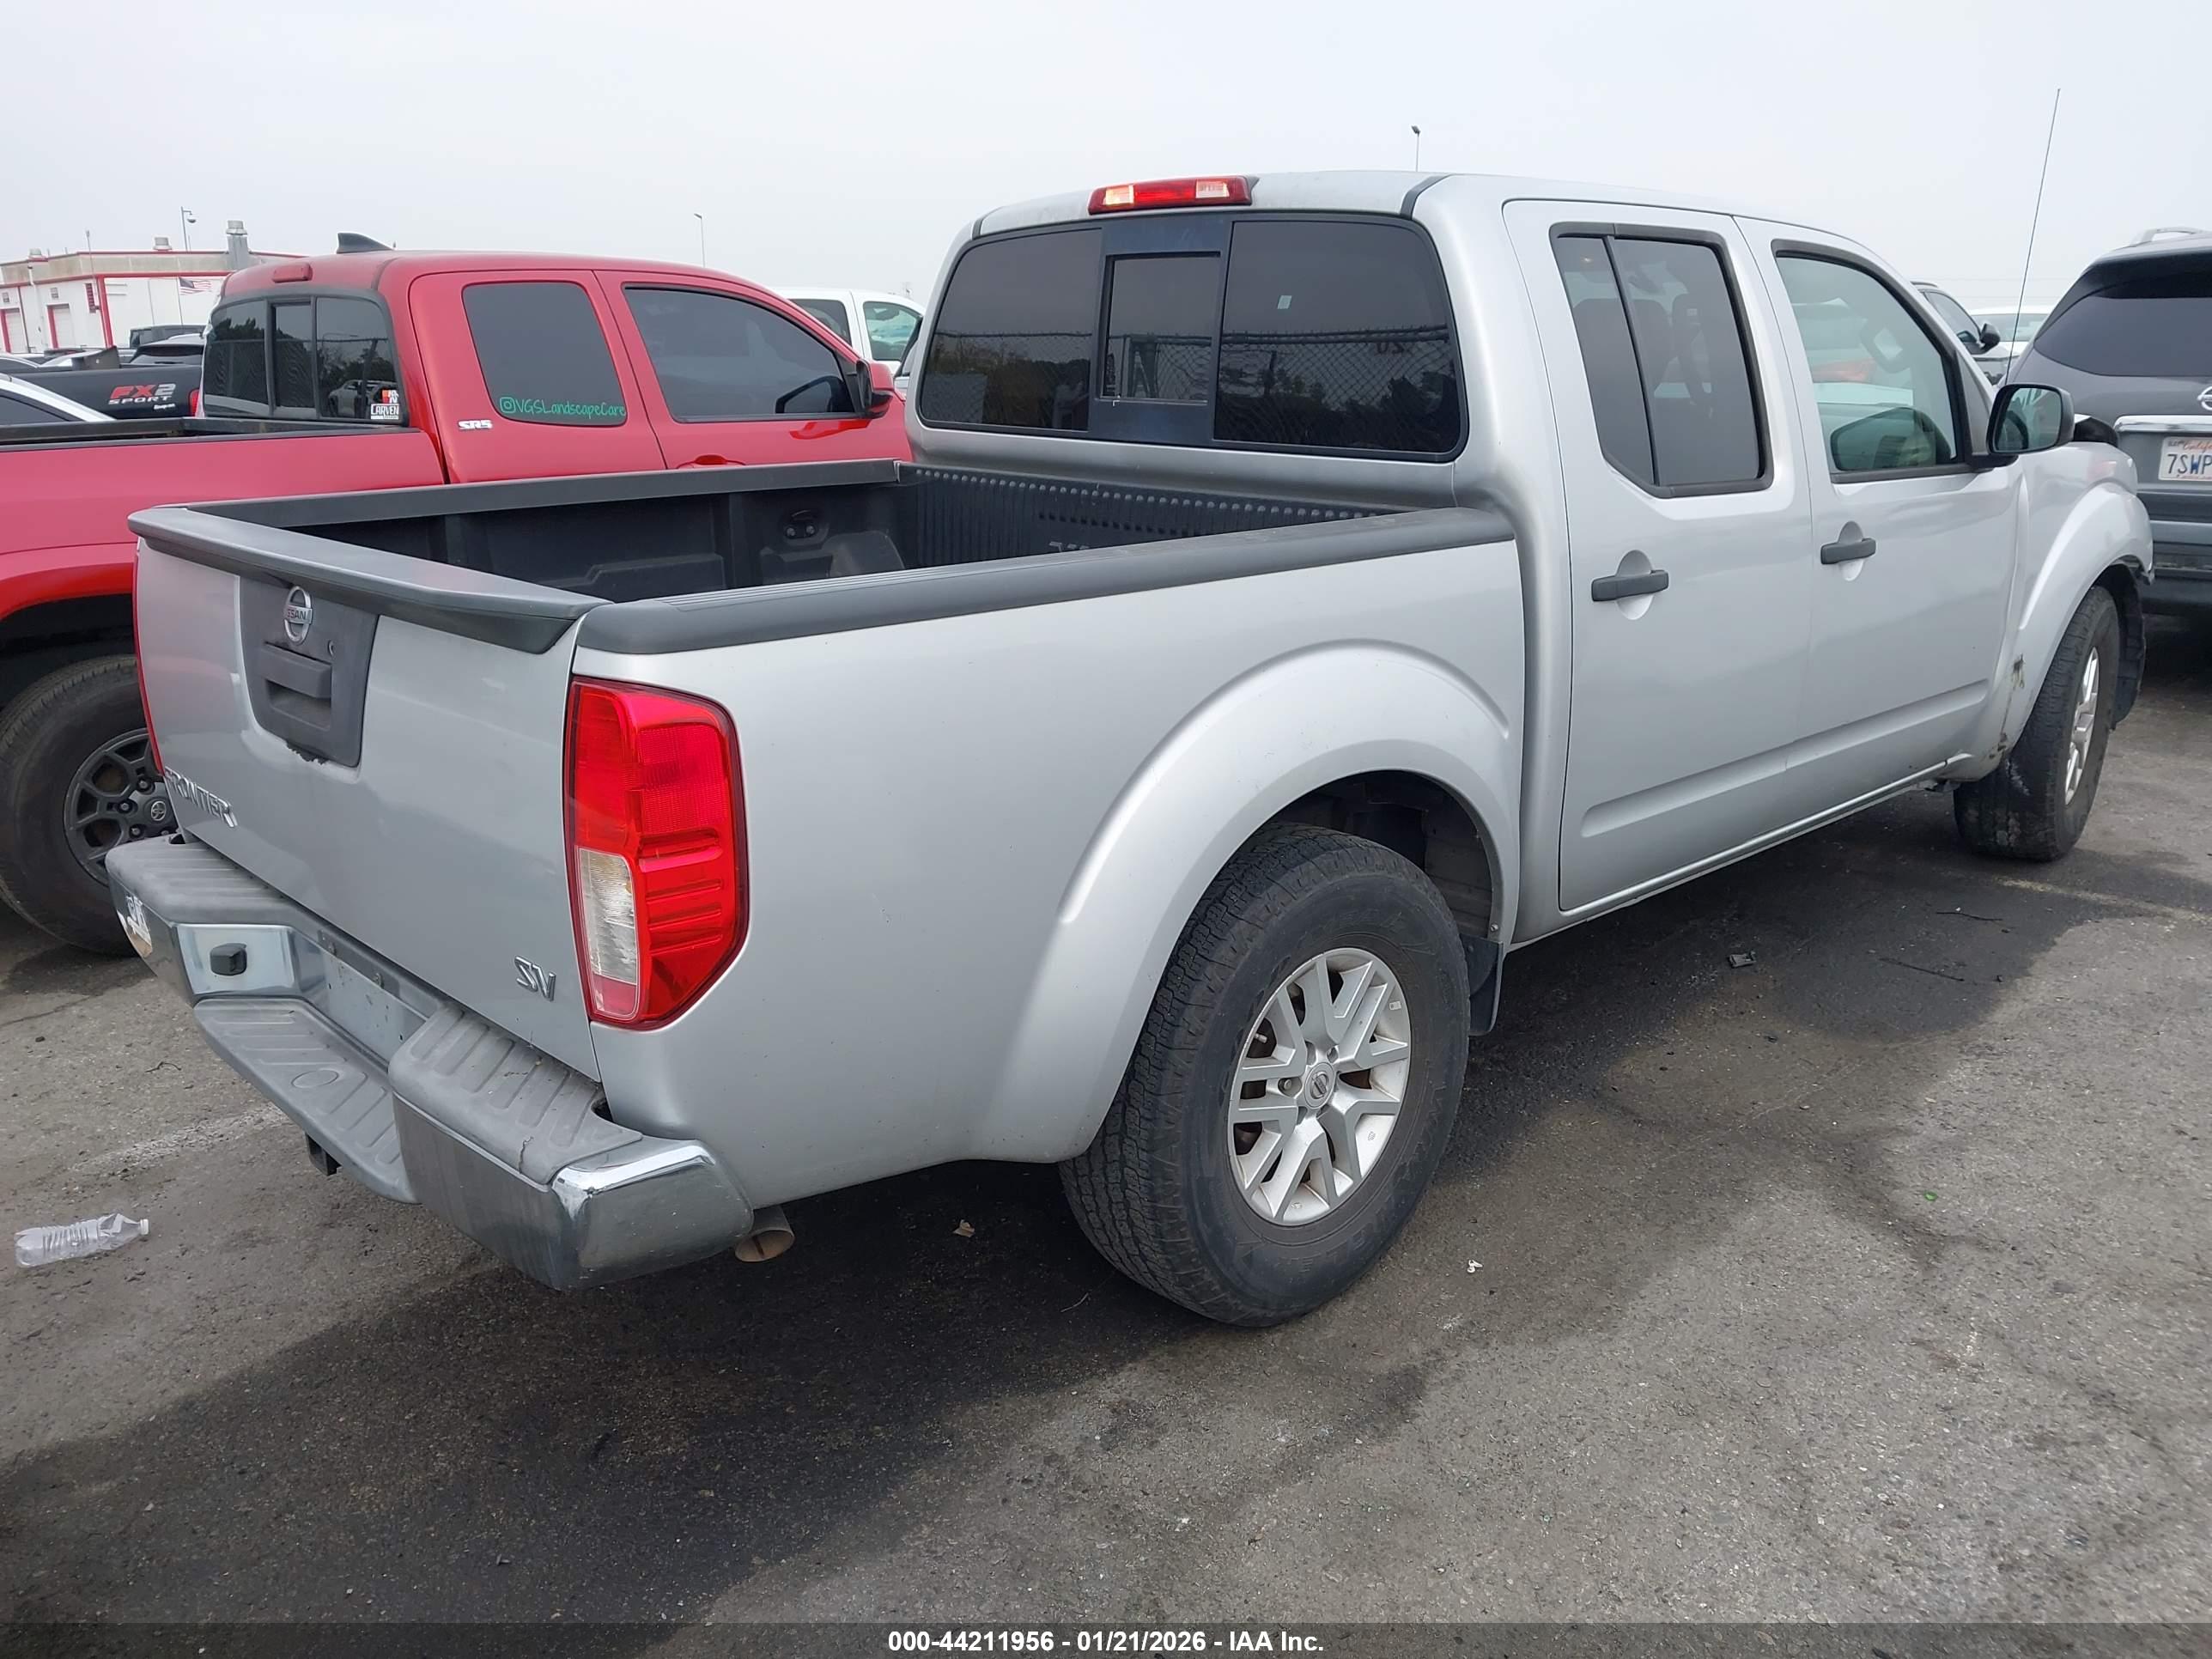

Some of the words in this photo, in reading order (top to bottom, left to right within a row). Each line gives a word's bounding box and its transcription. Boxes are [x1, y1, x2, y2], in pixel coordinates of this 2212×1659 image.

[110, 384, 176, 398] FX2
[108, 396, 172, 404] SPORT
[371, 404, 398, 416] CARVEN
[459, 420, 493, 430] SR5
[2167, 453, 2212, 474] 7SWP
[165, 766, 238, 828] FRONTIER
[514, 956, 556, 1002] SV
